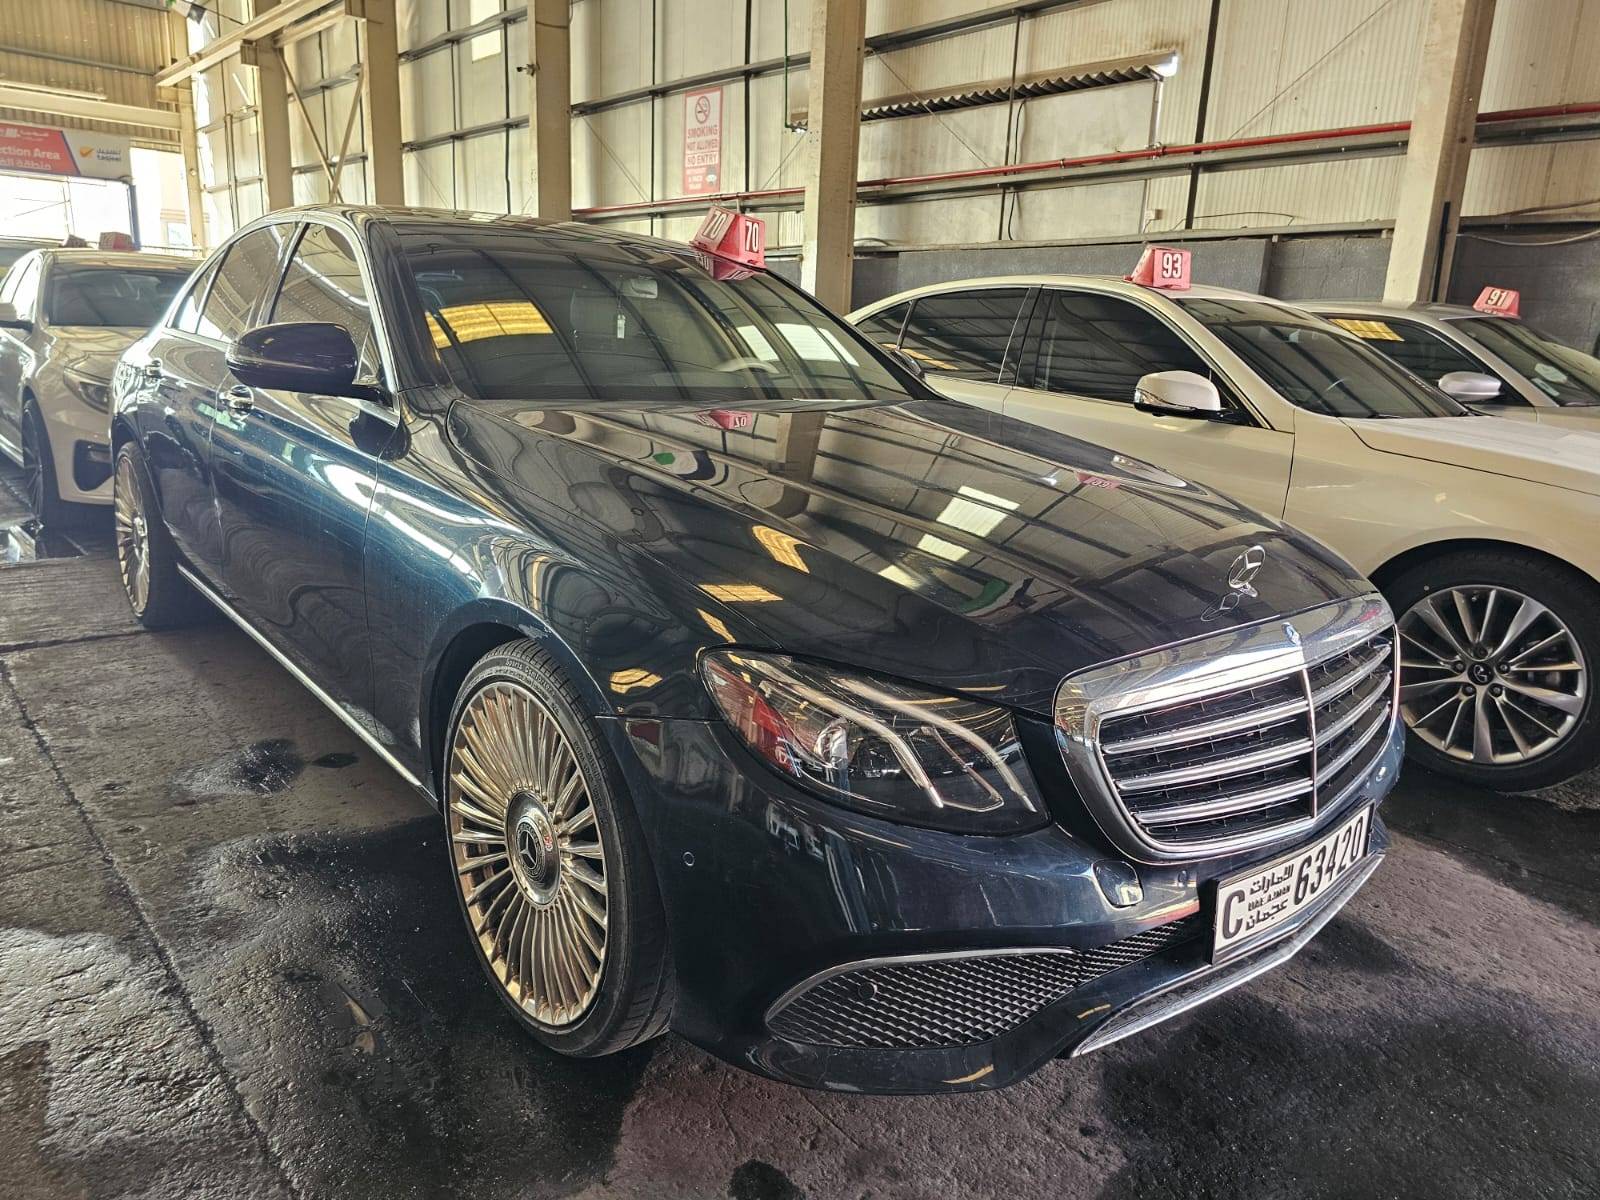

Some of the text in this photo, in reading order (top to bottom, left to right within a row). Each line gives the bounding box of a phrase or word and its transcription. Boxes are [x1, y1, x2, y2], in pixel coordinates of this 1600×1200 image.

[687, 125, 718, 138] SMOKING
[33, 148, 60, 160] Area
[687, 153, 717, 165] NO ENTRY
[703, 210, 727, 239] 70
[745, 220, 759, 252] 70
[1162, 252, 1182, 278] 93
[1487, 290, 1507, 307] 91
[1293, 815, 1364, 906] 63420
[1222, 889, 1246, 940] C
[1245, 898, 1289, 931] عجمان
